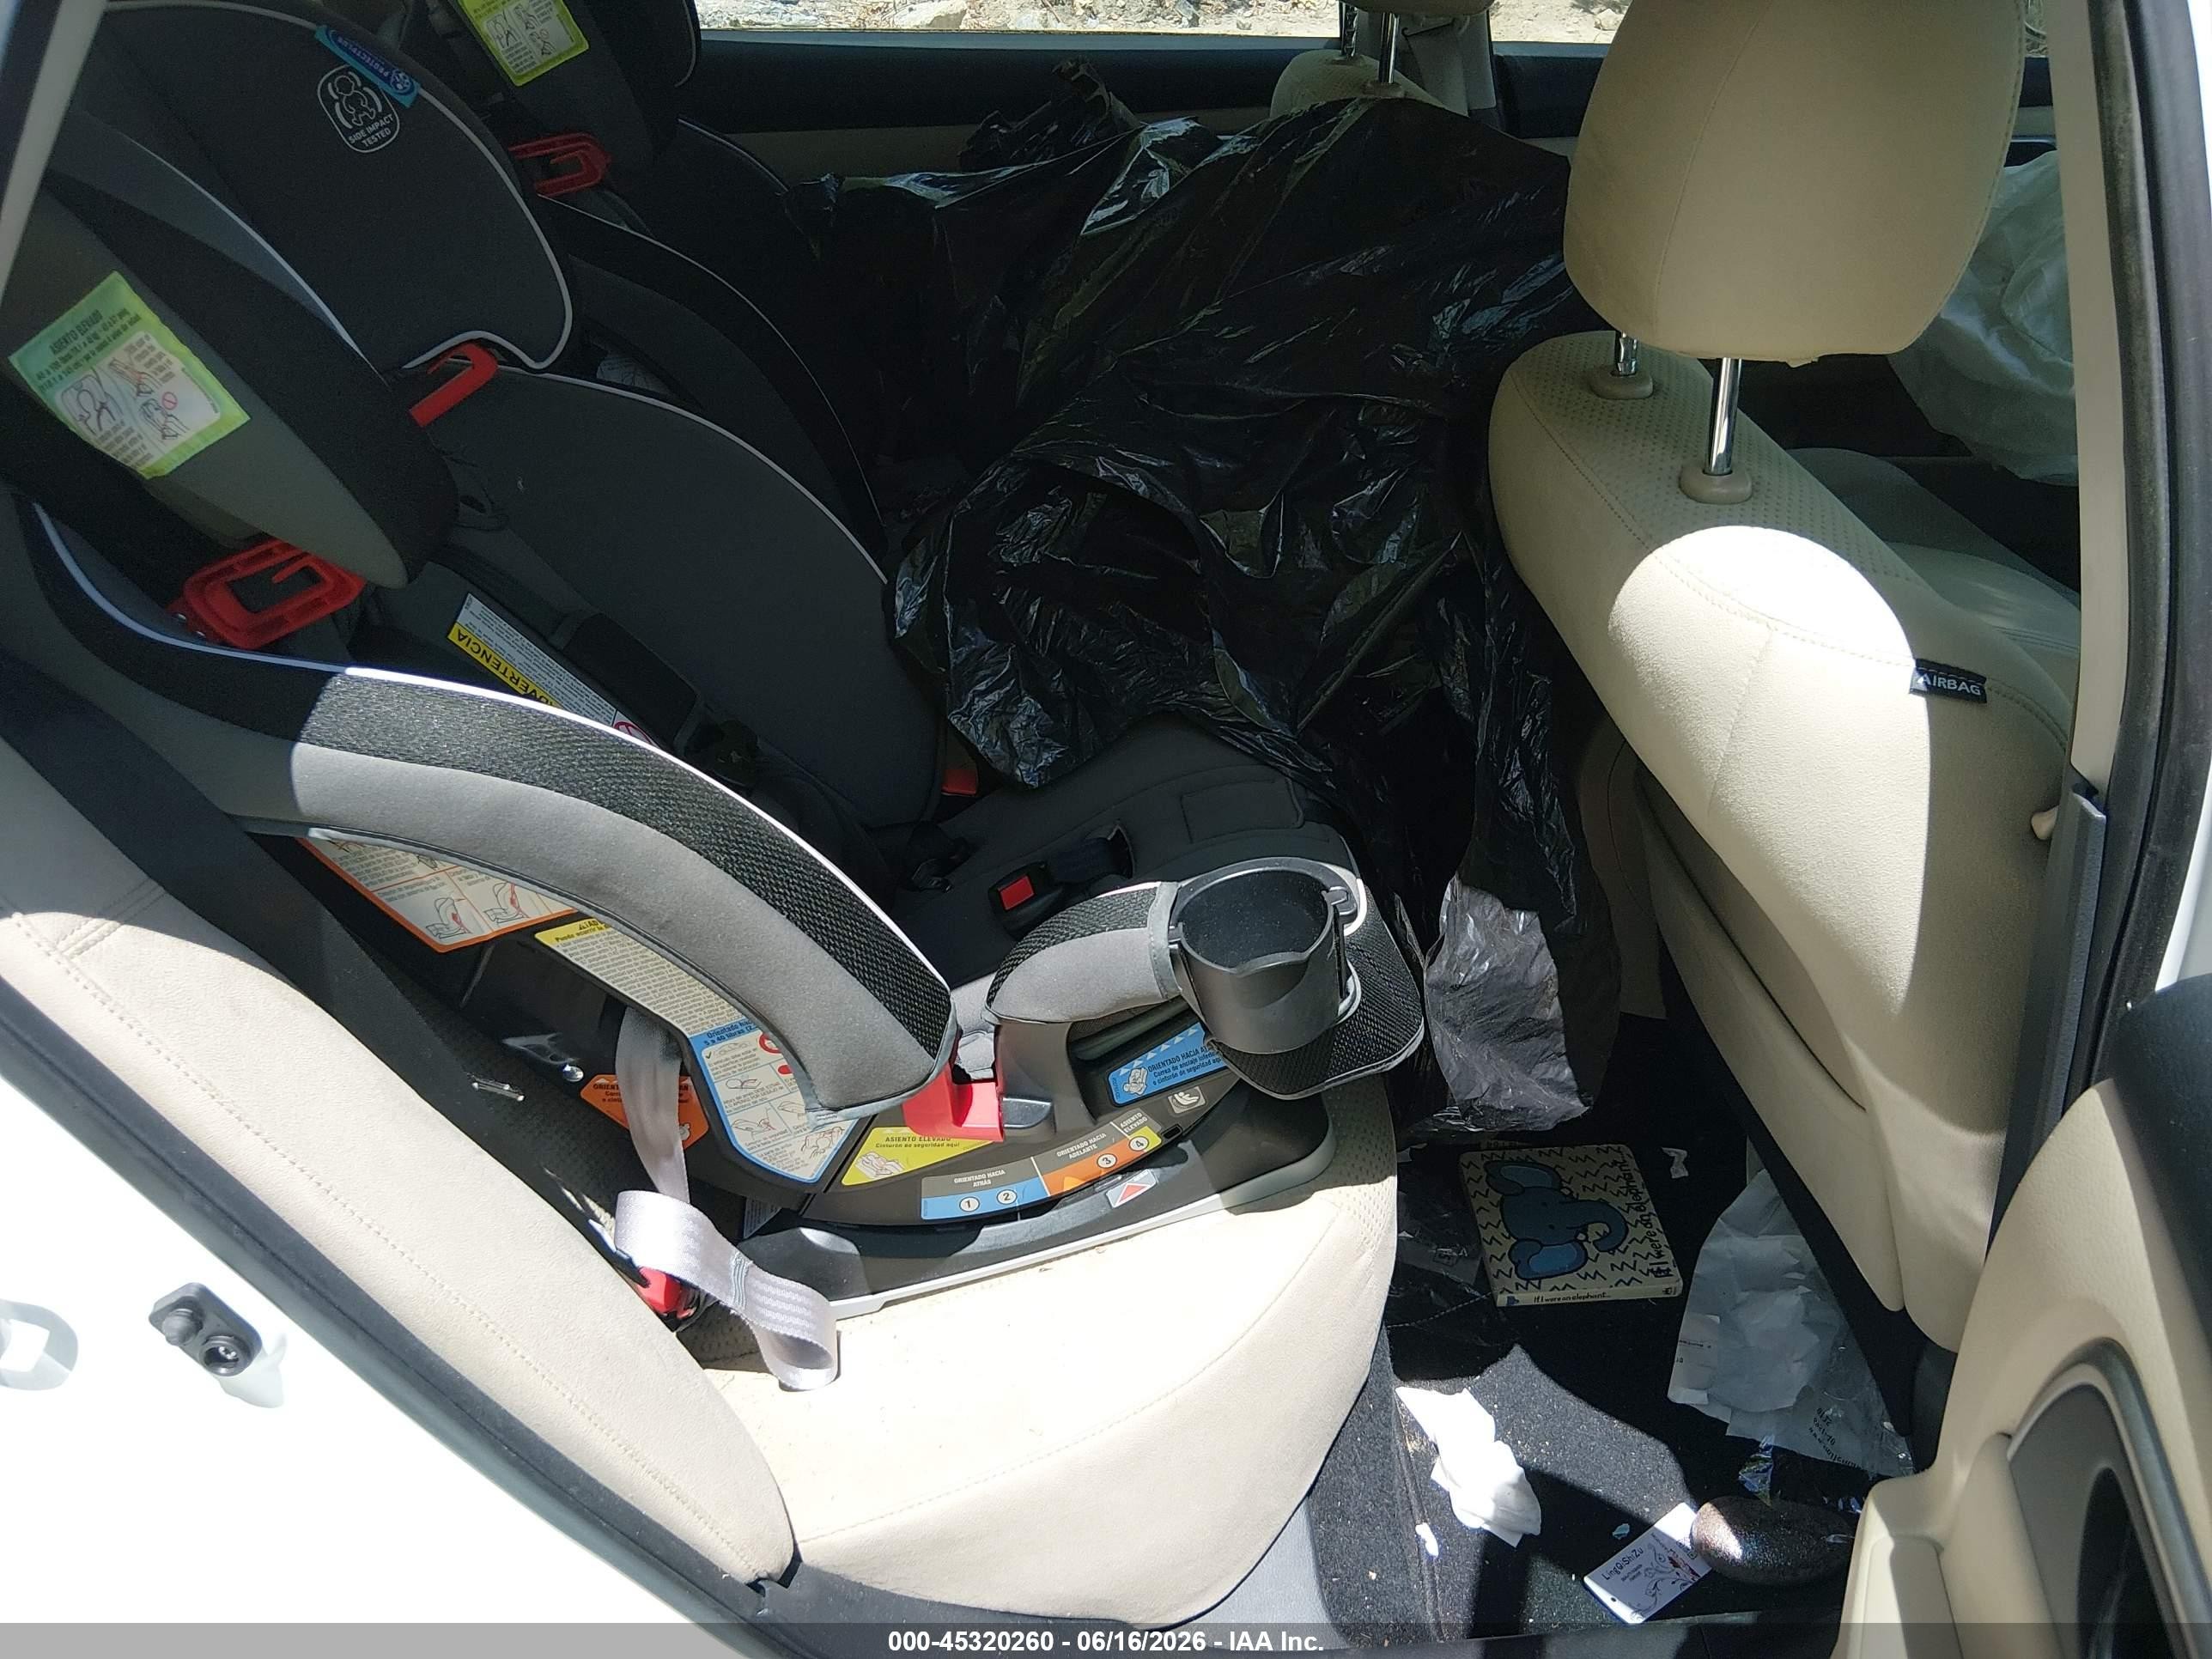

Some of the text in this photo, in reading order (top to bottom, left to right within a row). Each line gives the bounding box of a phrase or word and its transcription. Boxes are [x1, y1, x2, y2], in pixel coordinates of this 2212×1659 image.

[348, 112, 394, 143] SIDE IMPACT
[362, 126, 392, 147] TESTED
[455, 629, 555, 706] DVERTENCIA
[1917, 673, 1982, 696] AIRBAG
[707, 1023, 738, 1038] Orientado
[726, 1028, 744, 1038] libras
[1147, 1055, 1180, 1072] ORIENTADO
[1180, 1048, 1199, 1060] HACIA
[1152, 1066, 1171, 1077] Correa
[1178, 1056, 1198, 1068] anclaje
[1157, 1072, 1178, 1084] cinturón
[1186, 1060, 1211, 1073] seguridad
[1120, 1111, 1142, 1128] ASIENTO
[1123, 1115, 1147, 1133] ELEVADO
[1056, 1132, 1106, 1157] ORIENTADO HACIA
[1068, 1143, 1097, 1158] ADELANTE
[1134, 1139, 1145, 1149] 4
[1103, 1156, 1112, 1166] 3
[953, 1169, 1005, 1183] ORIENTADO HACIA
[965, 1200, 971, 1209] 1
[1002, 1192, 1011, 1201] 2
[1645, 1230, 1665, 1258] were
